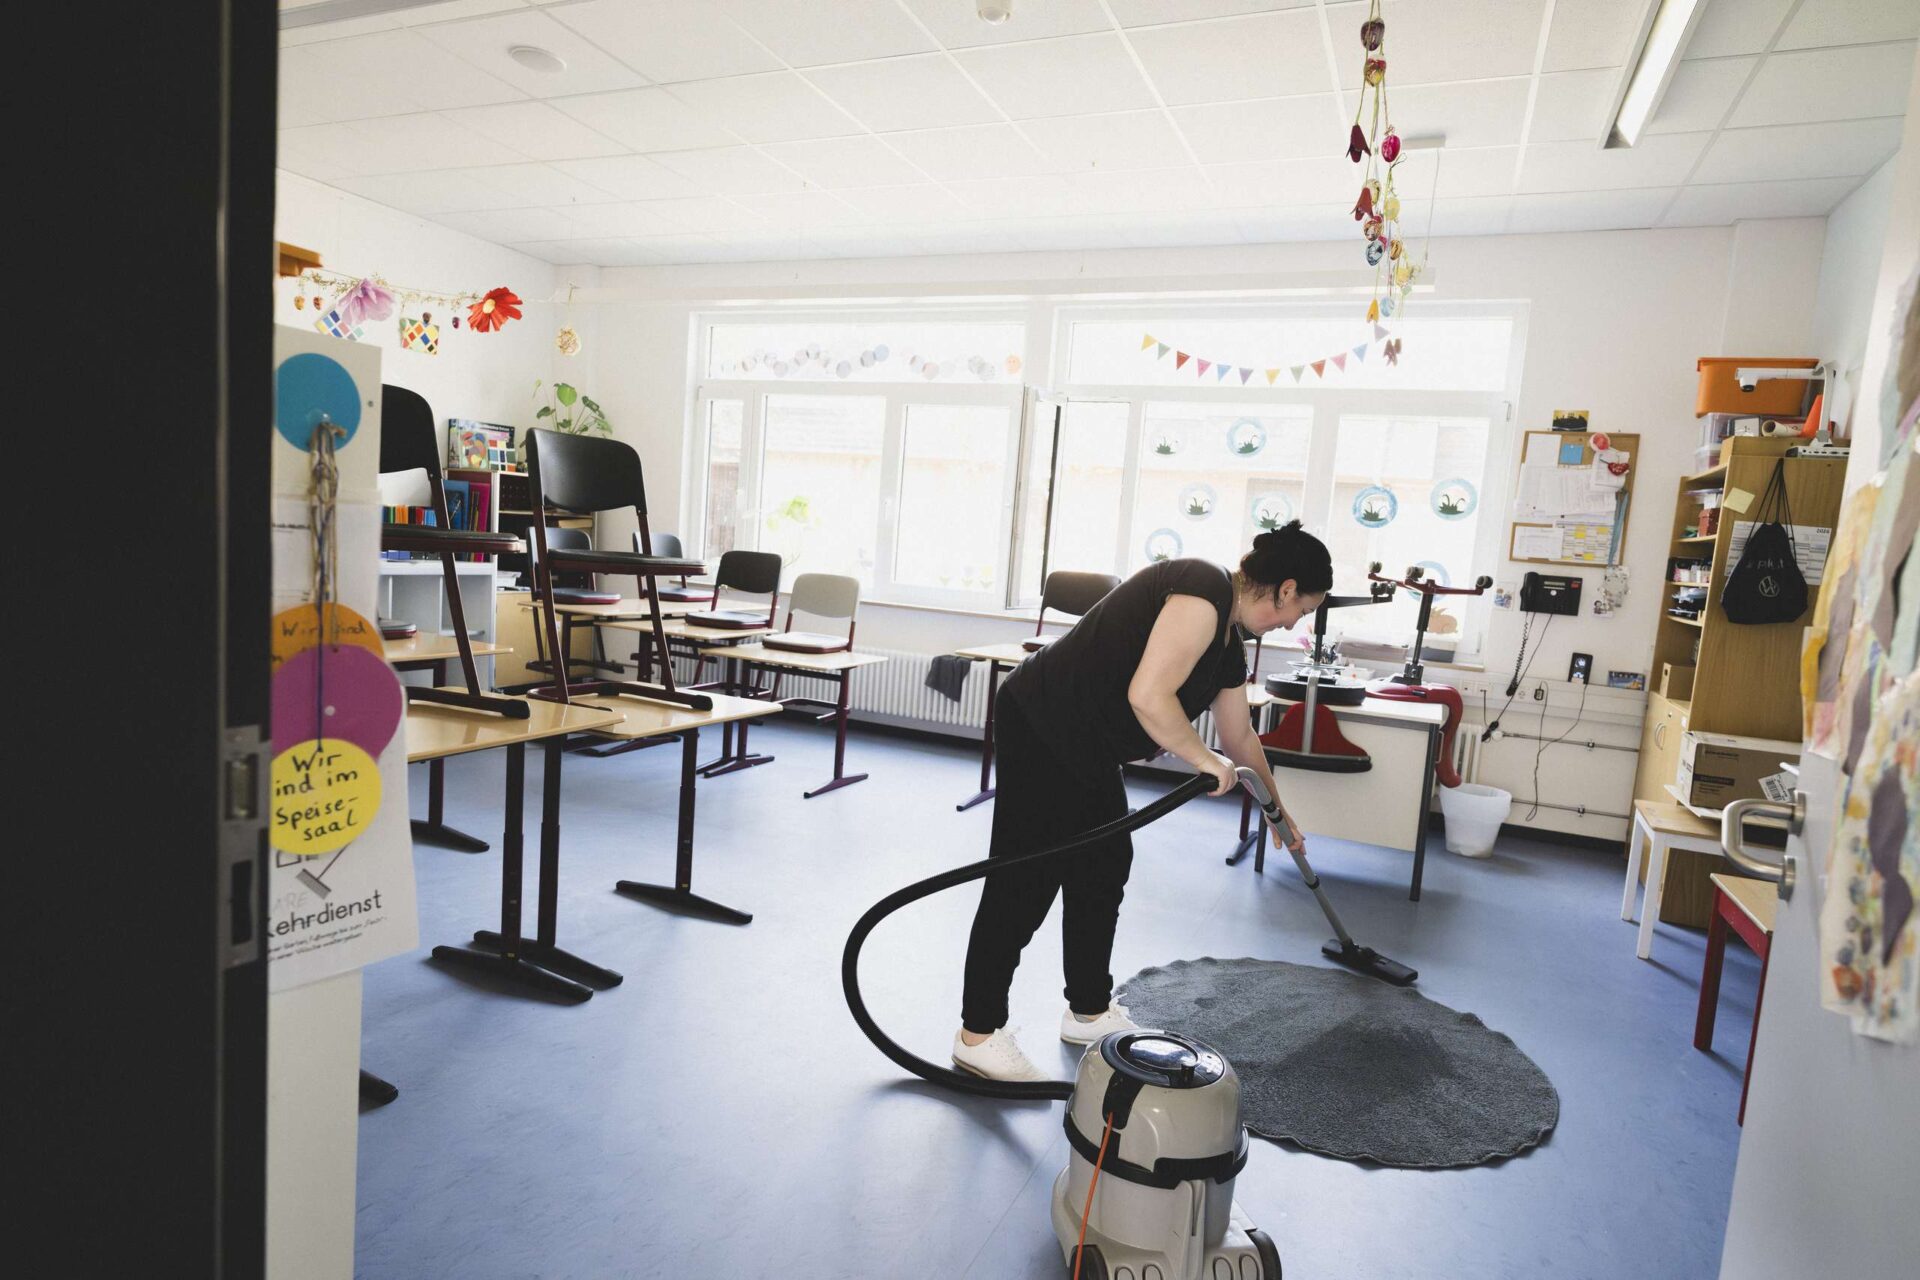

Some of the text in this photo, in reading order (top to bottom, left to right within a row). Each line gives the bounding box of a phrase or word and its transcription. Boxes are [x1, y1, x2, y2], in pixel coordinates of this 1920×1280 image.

[292, 751, 342, 773] Wir
[275, 770, 358, 796] ind im
[275, 796, 358, 830] Speise-
[303, 809, 358, 841] saal
